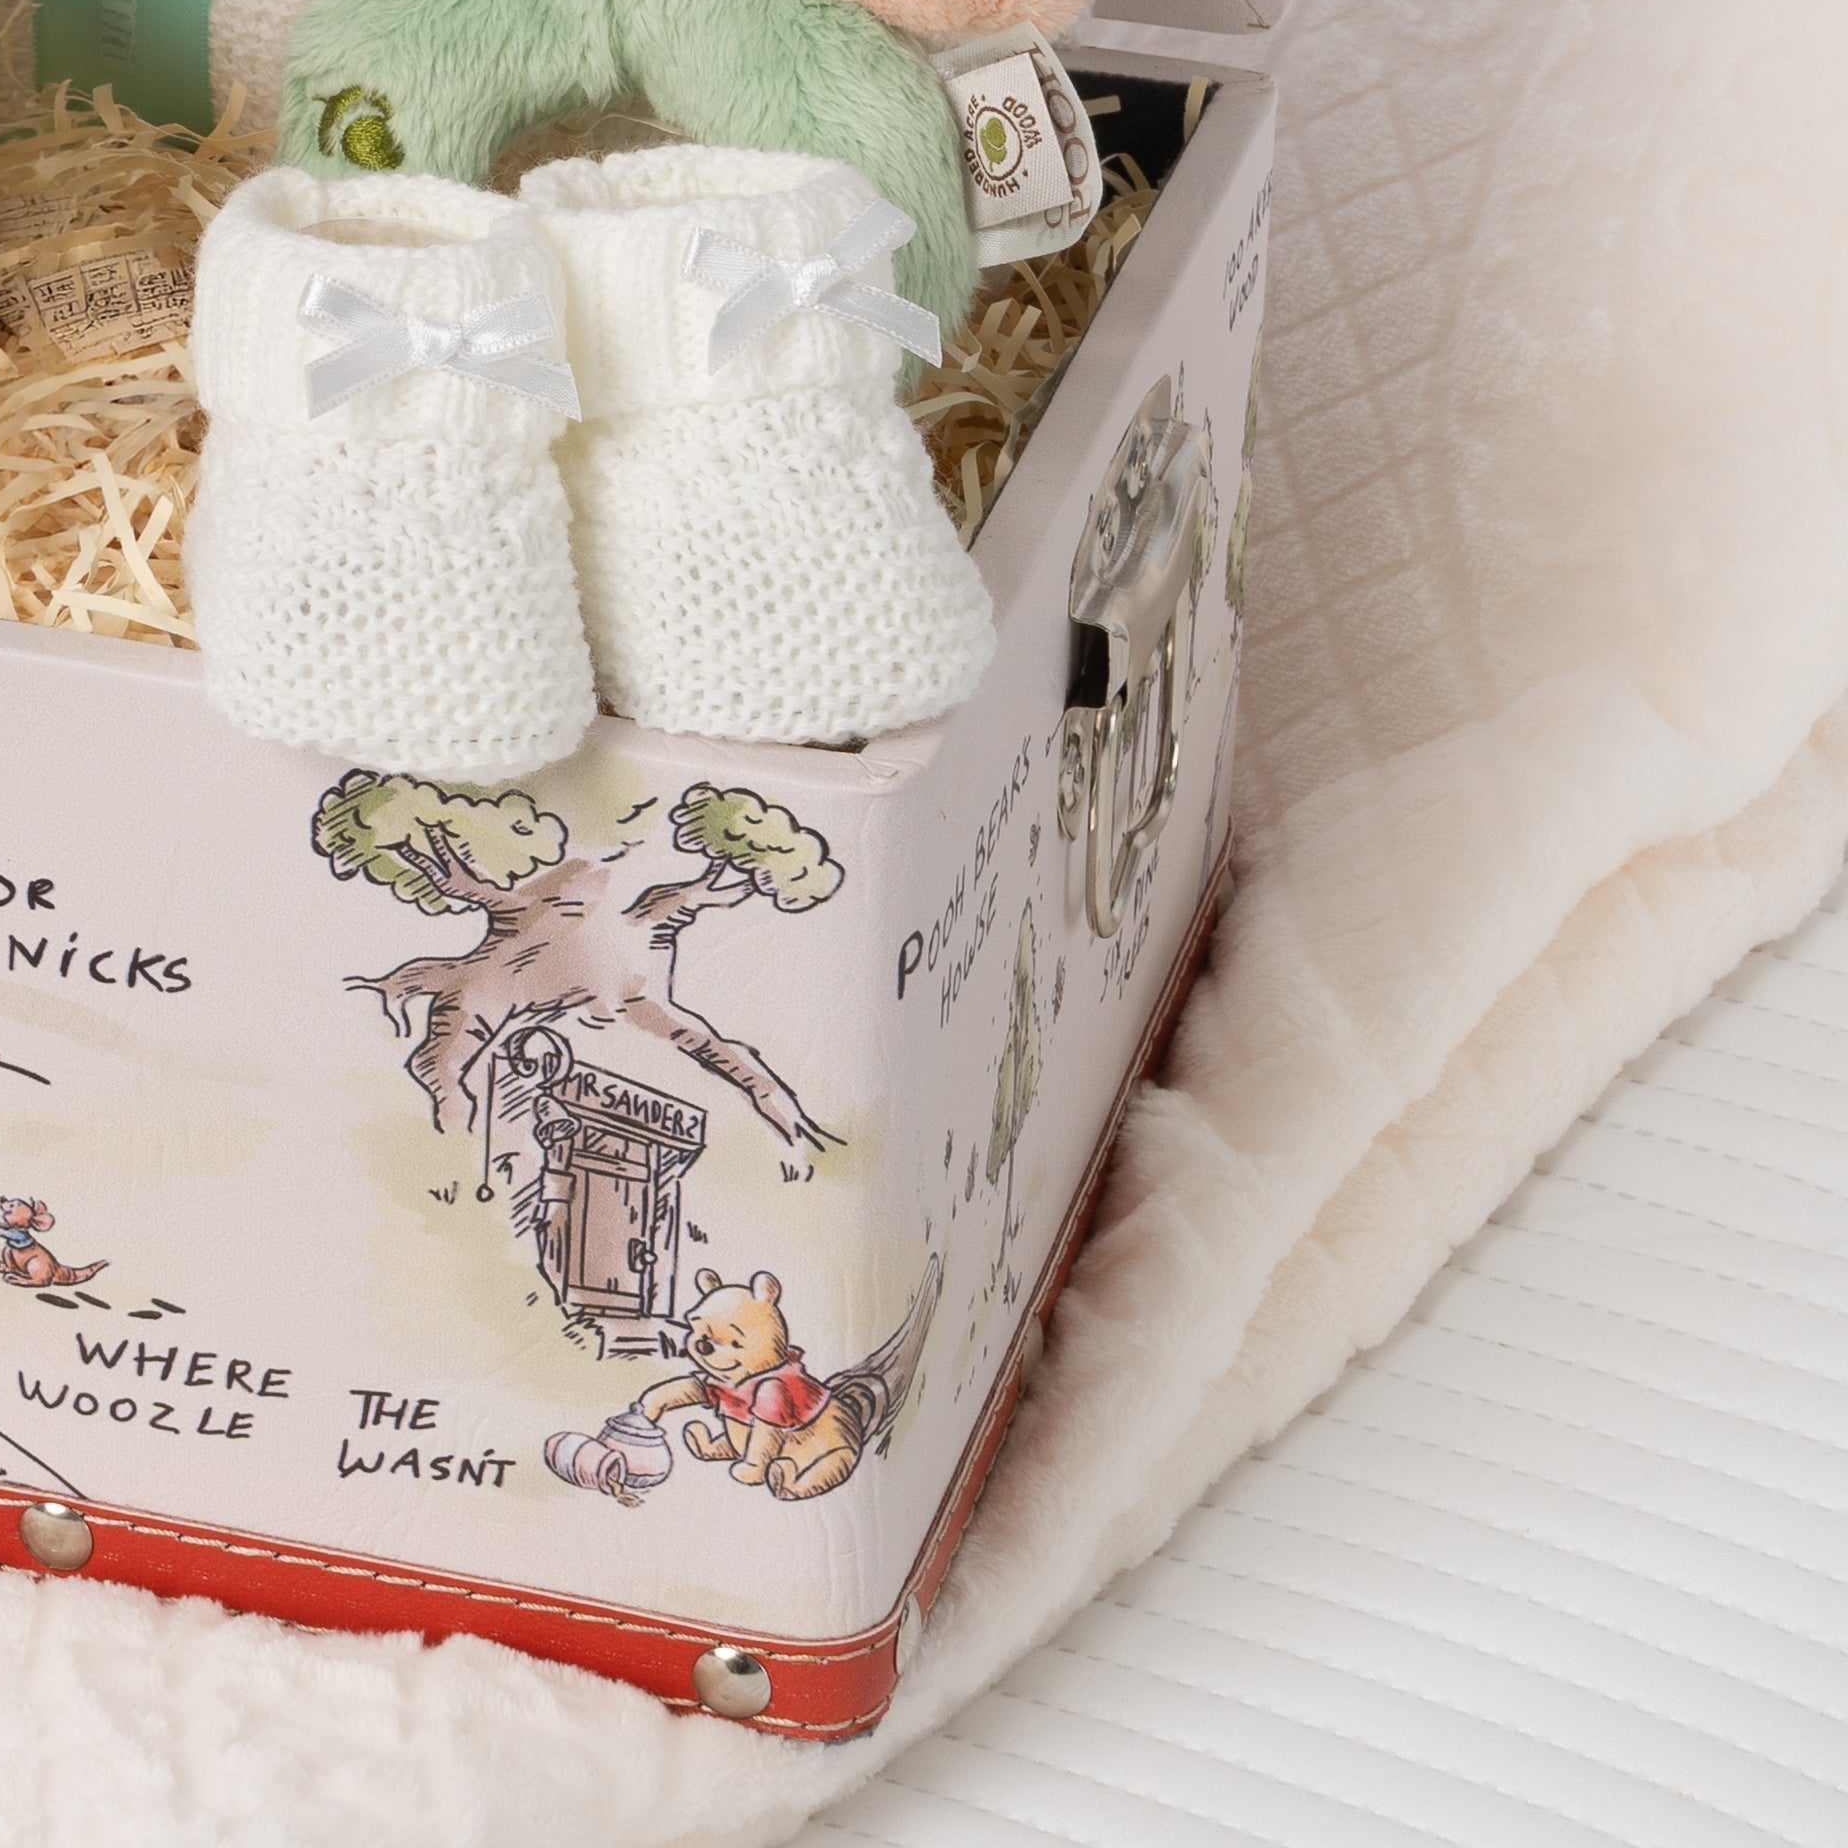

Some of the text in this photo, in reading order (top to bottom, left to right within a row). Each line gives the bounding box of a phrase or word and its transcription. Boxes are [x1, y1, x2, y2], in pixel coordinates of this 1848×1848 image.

[1002, 96, 1042, 150] WOOD
[963, 148, 1021, 199] HUNDRED
[896, 864, 966, 1001] POOH
[17, 1370, 254, 1439] WOOZLE
[75, 1332, 440, 1430] WHERE THE
